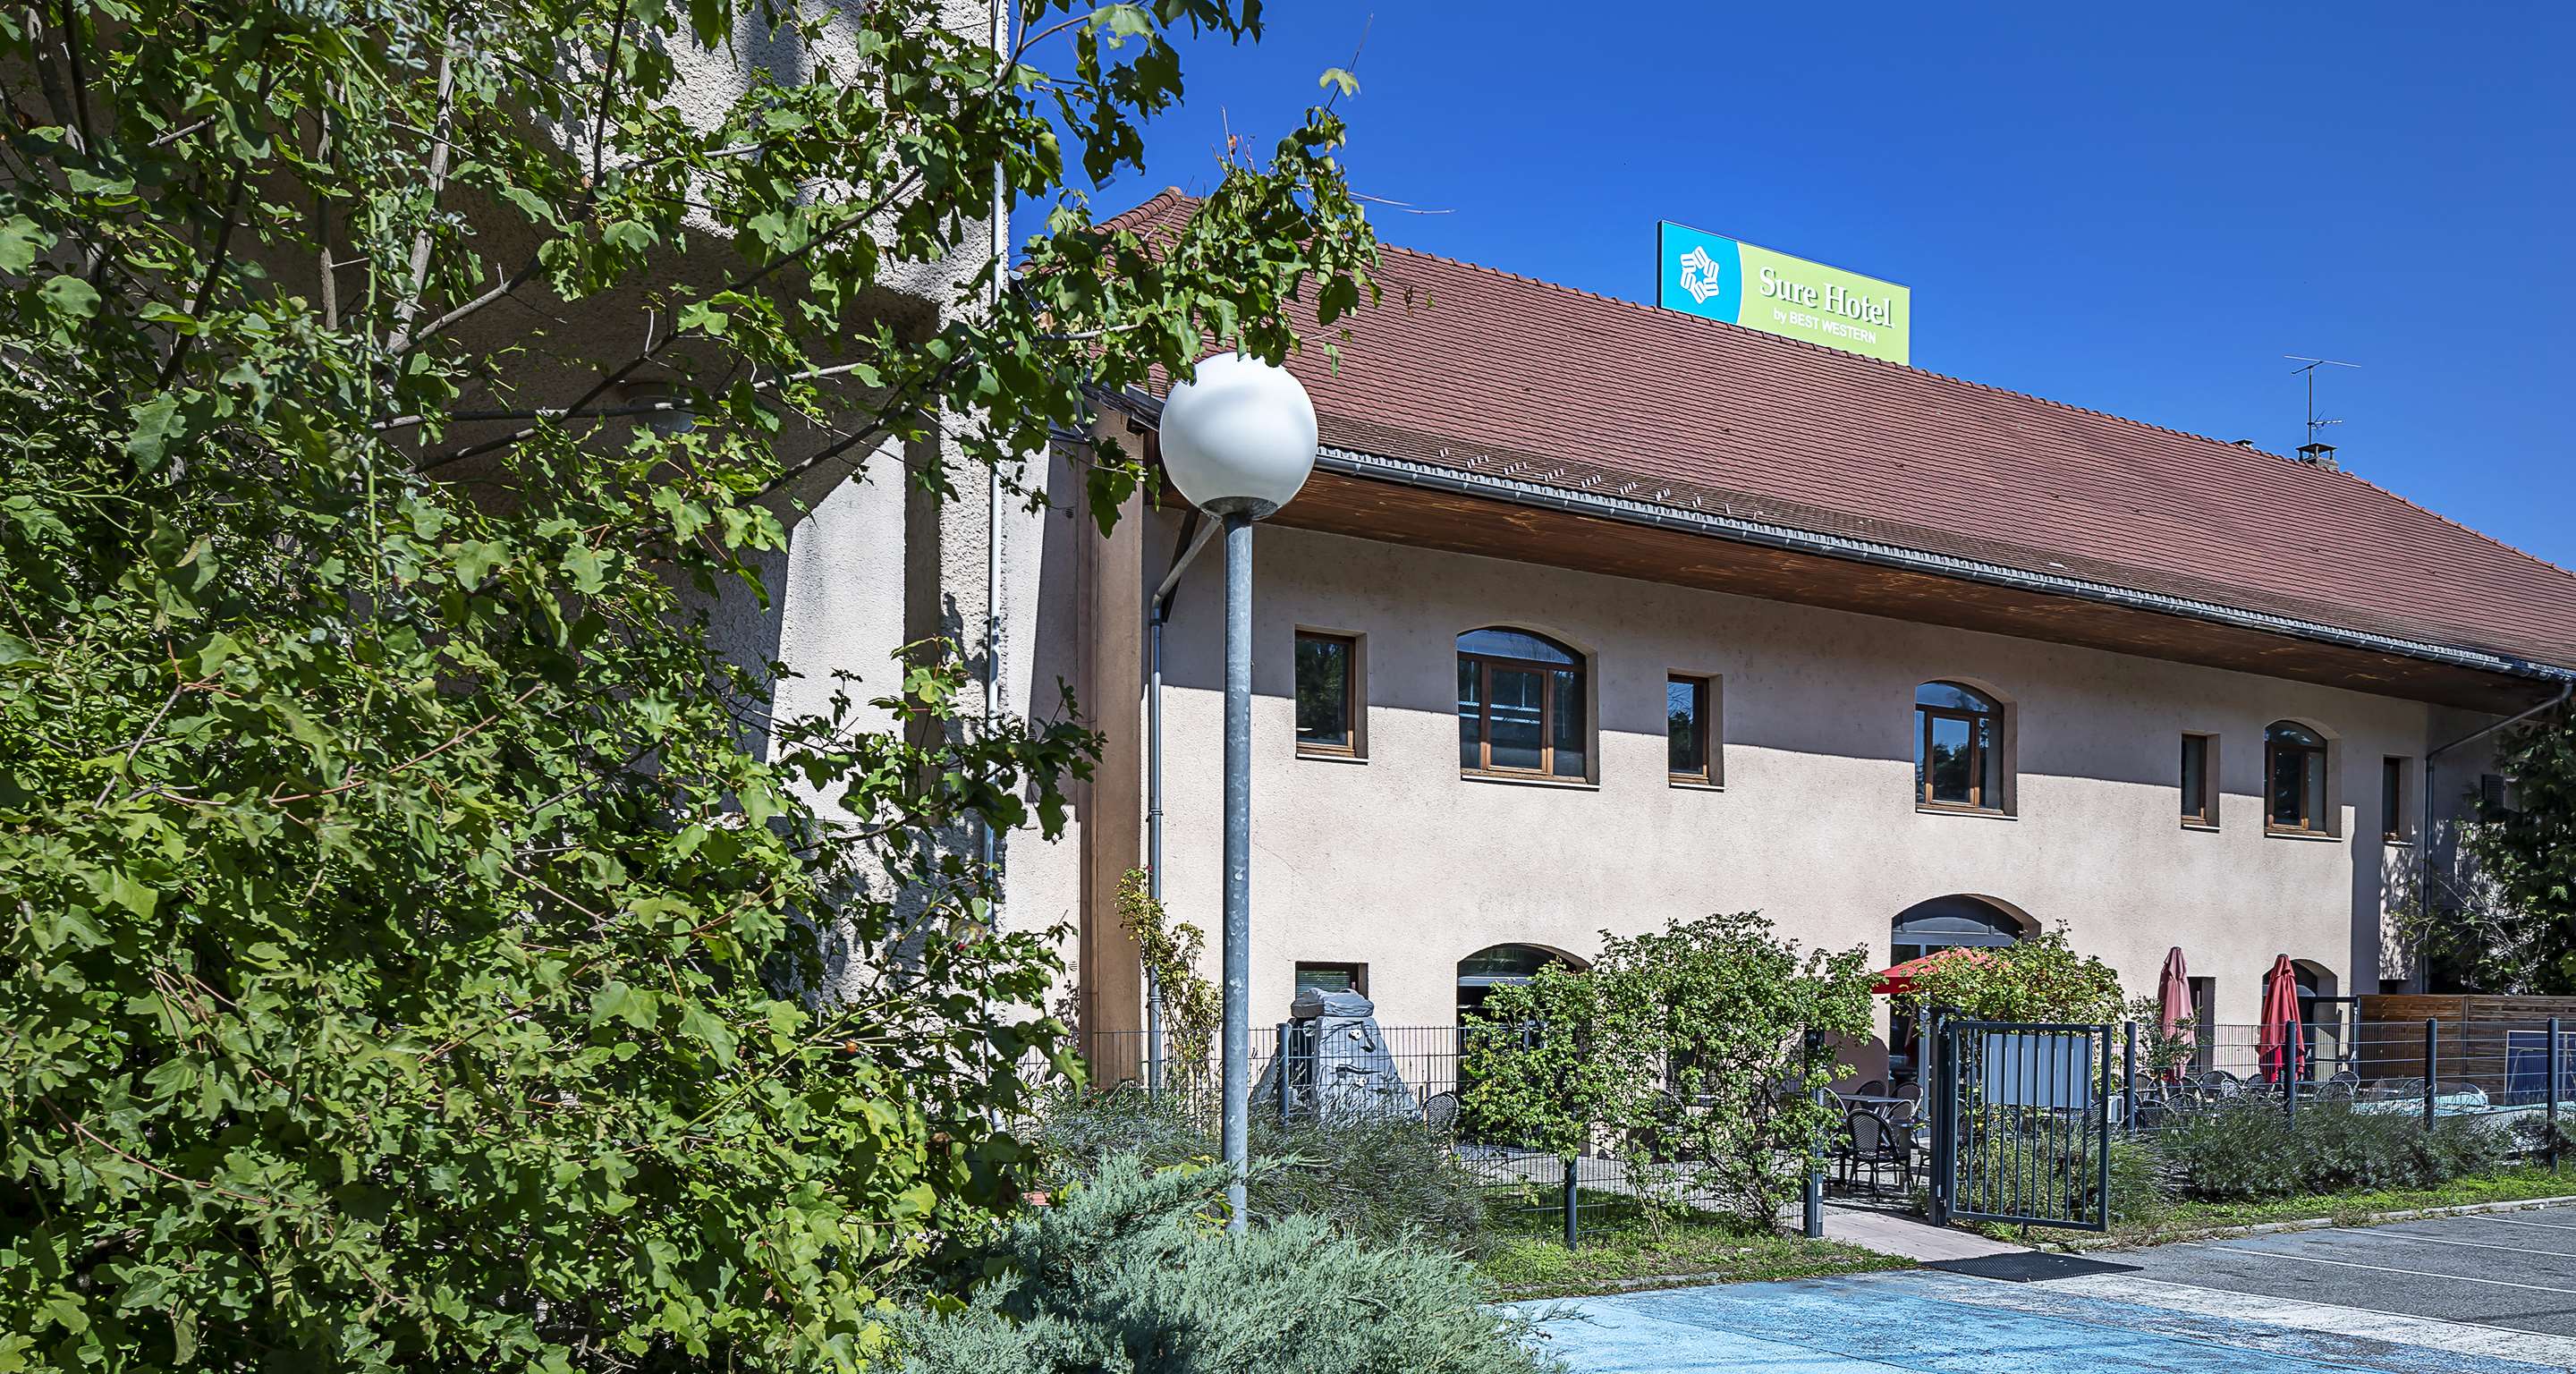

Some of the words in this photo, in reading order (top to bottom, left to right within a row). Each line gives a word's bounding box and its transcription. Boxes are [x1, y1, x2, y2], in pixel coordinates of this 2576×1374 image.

[1759, 266, 1818, 309] Sure
[1774, 307, 1787, 325] by
[1789, 311, 1819, 330] BEST
[1821, 318, 1877, 344] WESTERN
